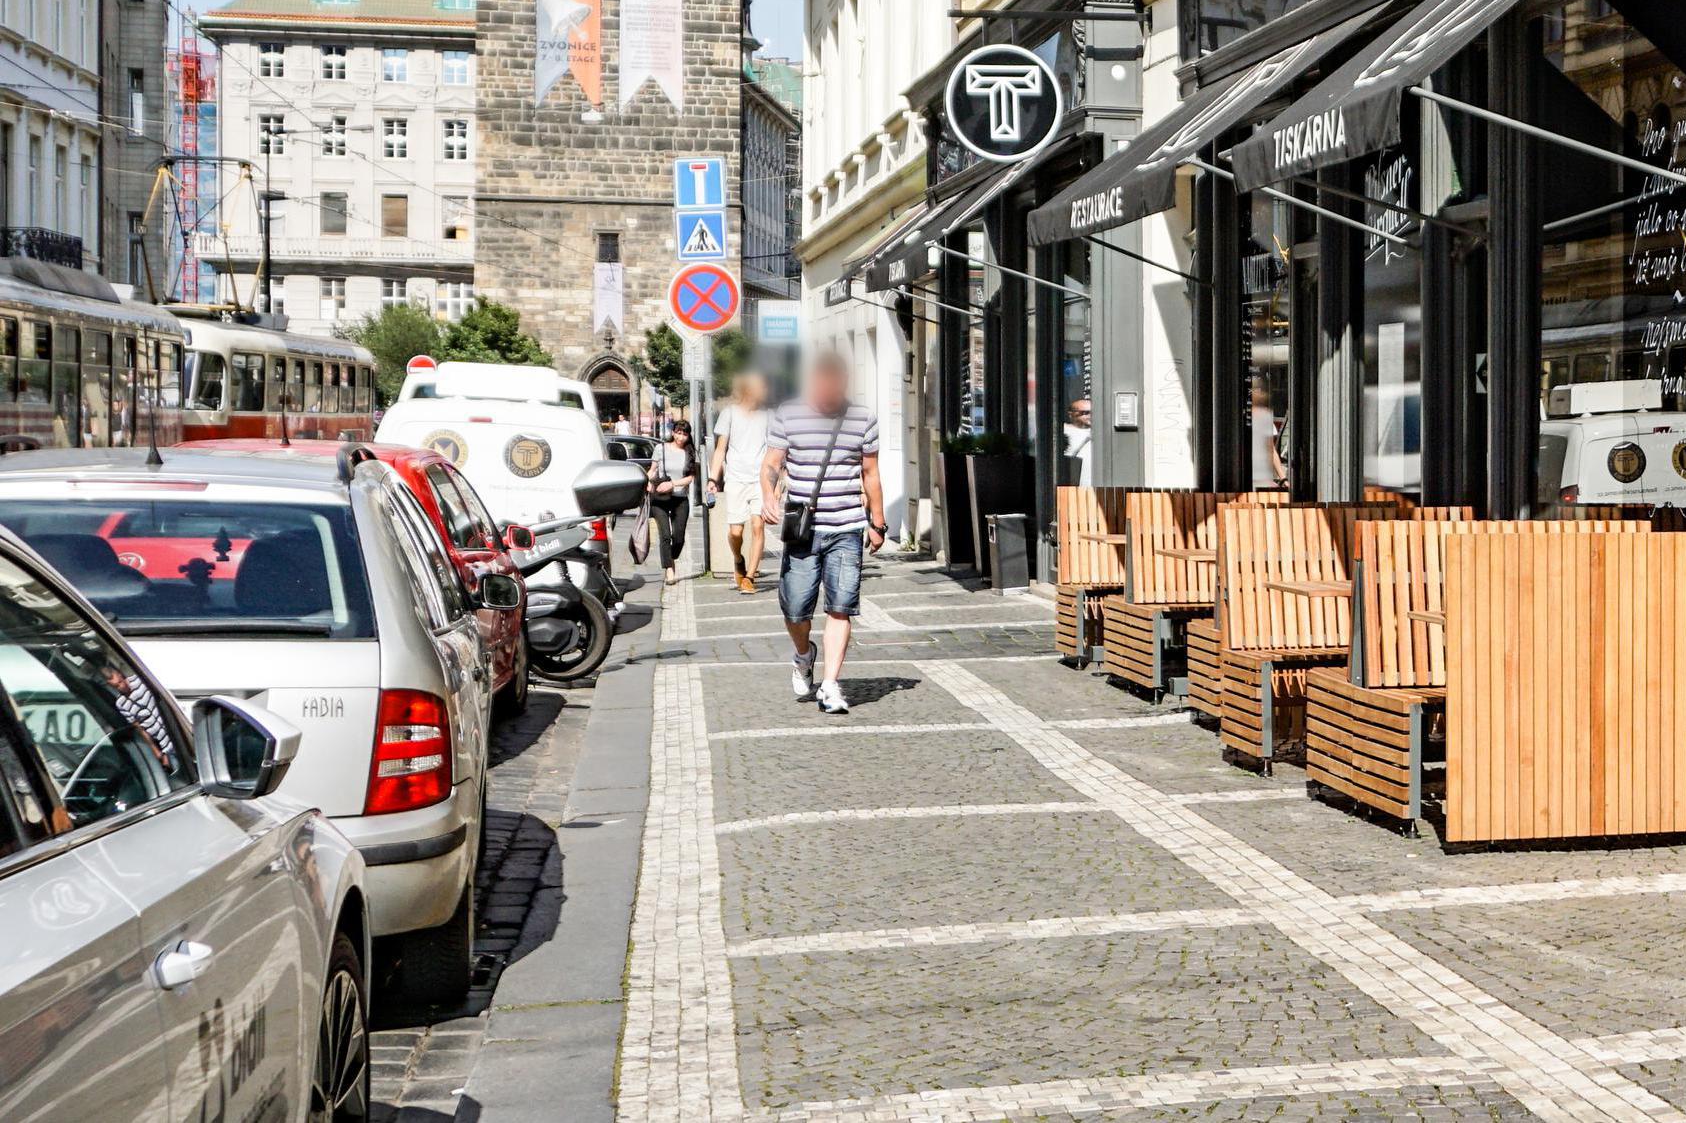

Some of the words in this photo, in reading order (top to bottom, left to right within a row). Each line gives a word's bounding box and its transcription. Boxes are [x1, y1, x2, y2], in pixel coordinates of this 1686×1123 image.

[540, 40, 597, 52] ZVONICE
[965, 64, 1042, 143] T
[1272, 105, 1347, 171] TISKÁRNA
[1070, 186, 1123, 229] RESTAURACE
[302, 696, 344, 717] FABIA
